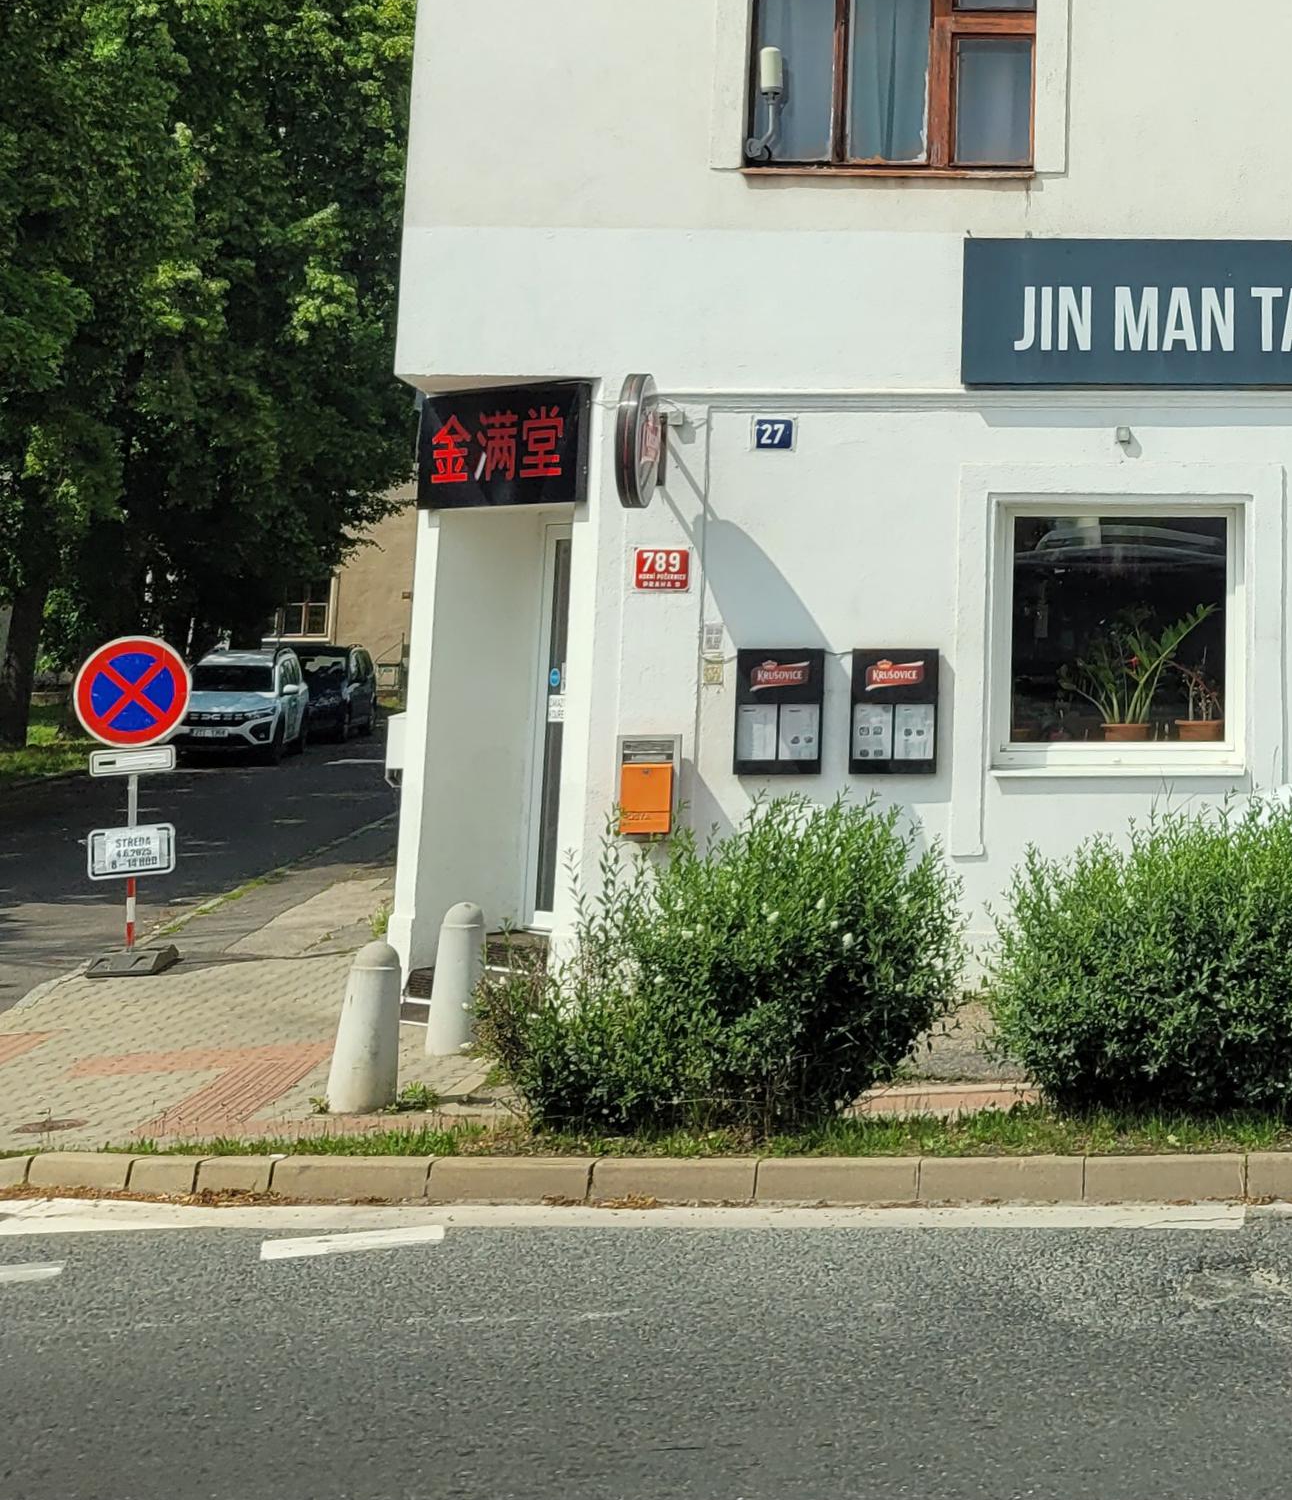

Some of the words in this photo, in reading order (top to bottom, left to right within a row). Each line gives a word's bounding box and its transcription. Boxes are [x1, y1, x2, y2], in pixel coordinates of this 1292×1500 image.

[1013, 285, 1093, 352] JIN
[1114, 285, 1236, 352] MAN
[431, 405, 564, 484] 金满堂
[760, 423, 785, 445] 27
[642, 551, 681, 573] 789
